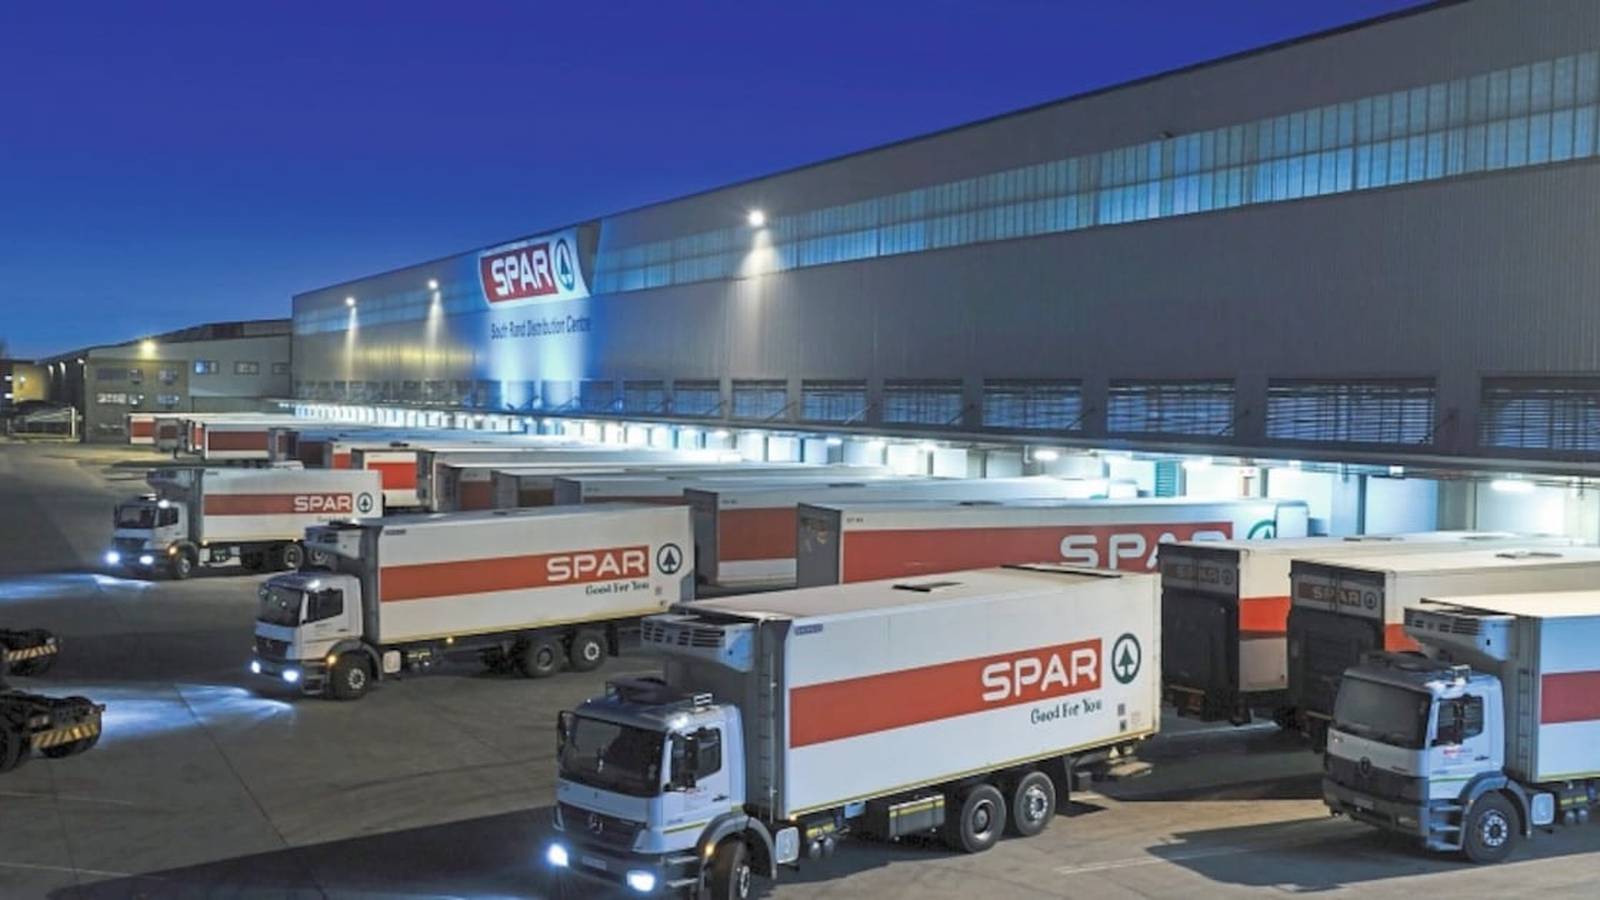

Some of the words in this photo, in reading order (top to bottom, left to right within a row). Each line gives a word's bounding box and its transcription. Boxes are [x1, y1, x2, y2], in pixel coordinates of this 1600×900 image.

[491, 249, 553, 296] SPAR
[294, 495, 352, 512] SPAR
[547, 550, 646, 581] SPAR
[1060, 531, 1227, 569] SP
[1312, 585, 1361, 605] SPAR
[982, 648, 1098, 702] SPAR
[1031, 702, 1060, 724] Good
[1062, 700, 1080, 718] For
[1082, 698, 1103, 713] You
